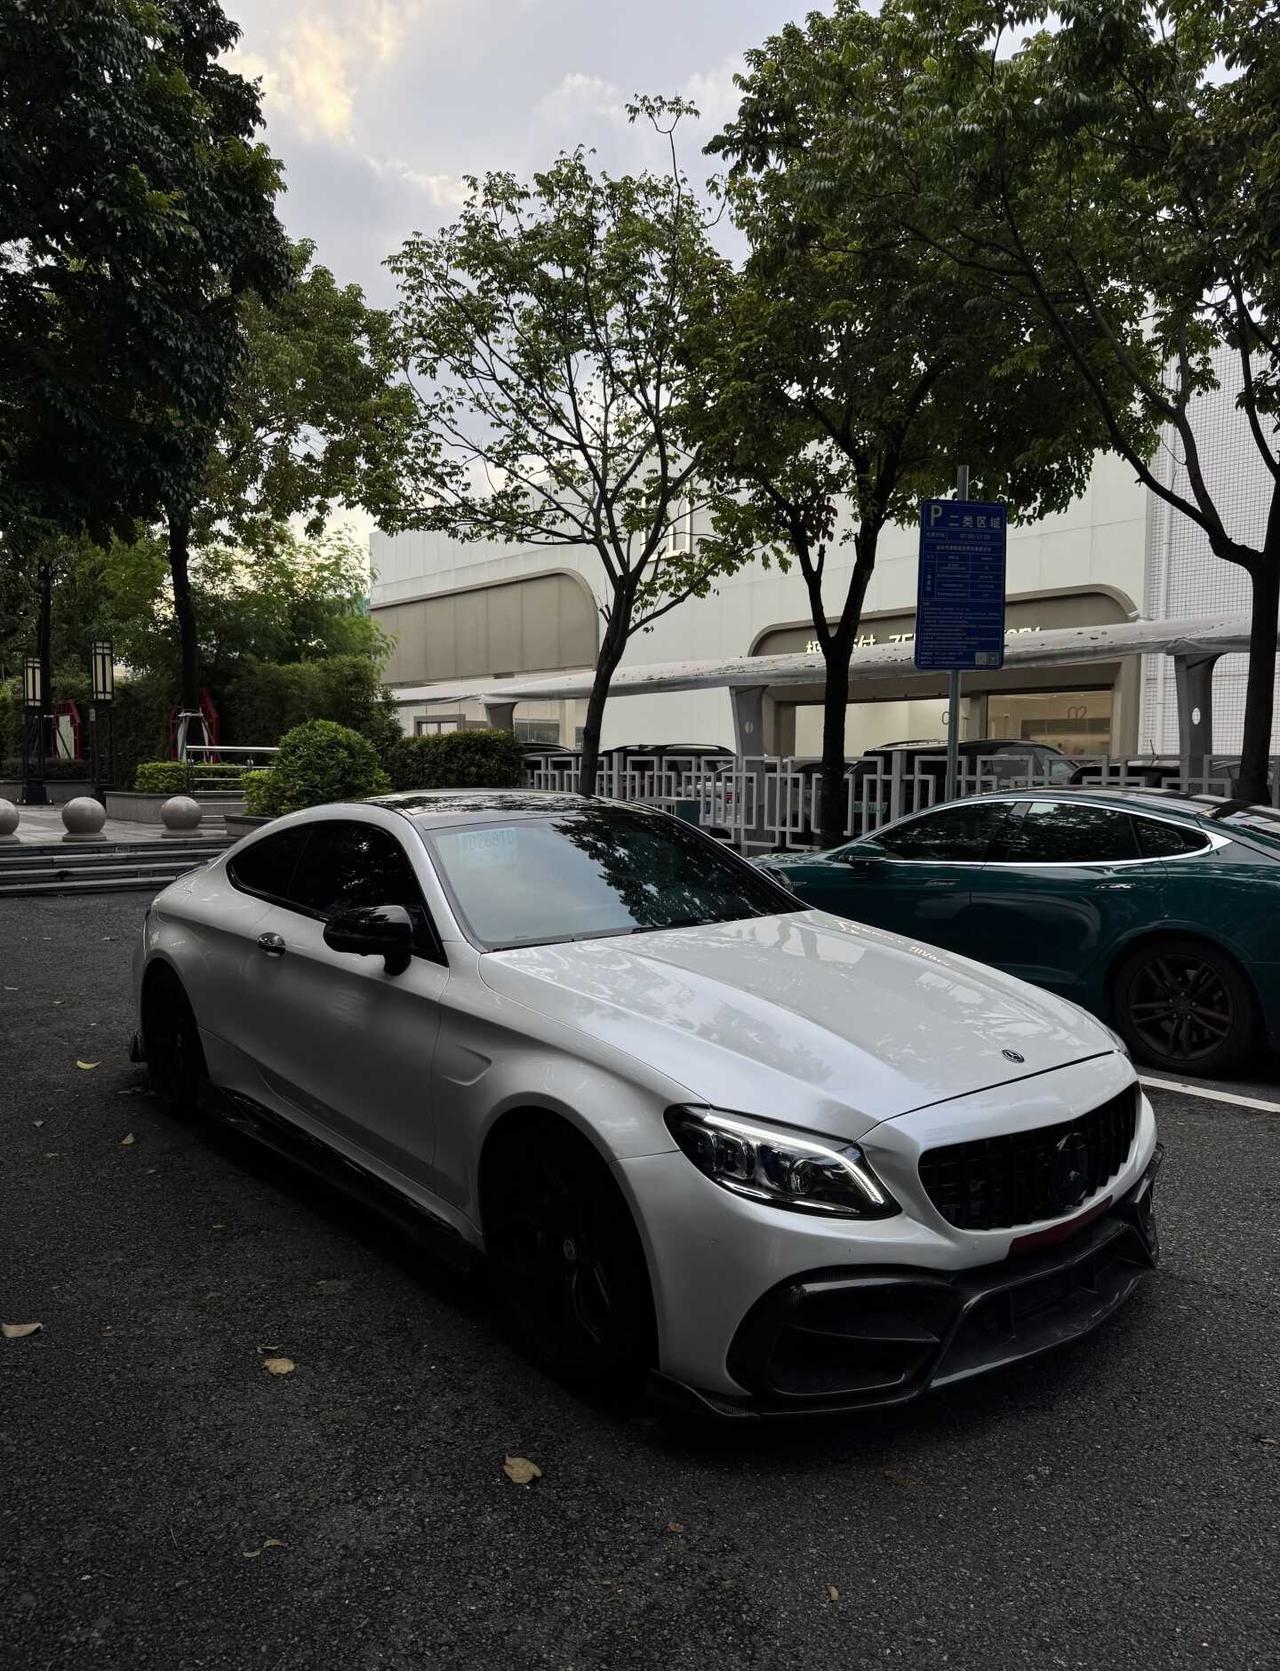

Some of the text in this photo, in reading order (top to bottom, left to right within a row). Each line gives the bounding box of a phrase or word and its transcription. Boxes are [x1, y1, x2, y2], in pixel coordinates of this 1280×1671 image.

[930, 504, 943, 527] P
[948, 514, 1002, 529] 二类区域
